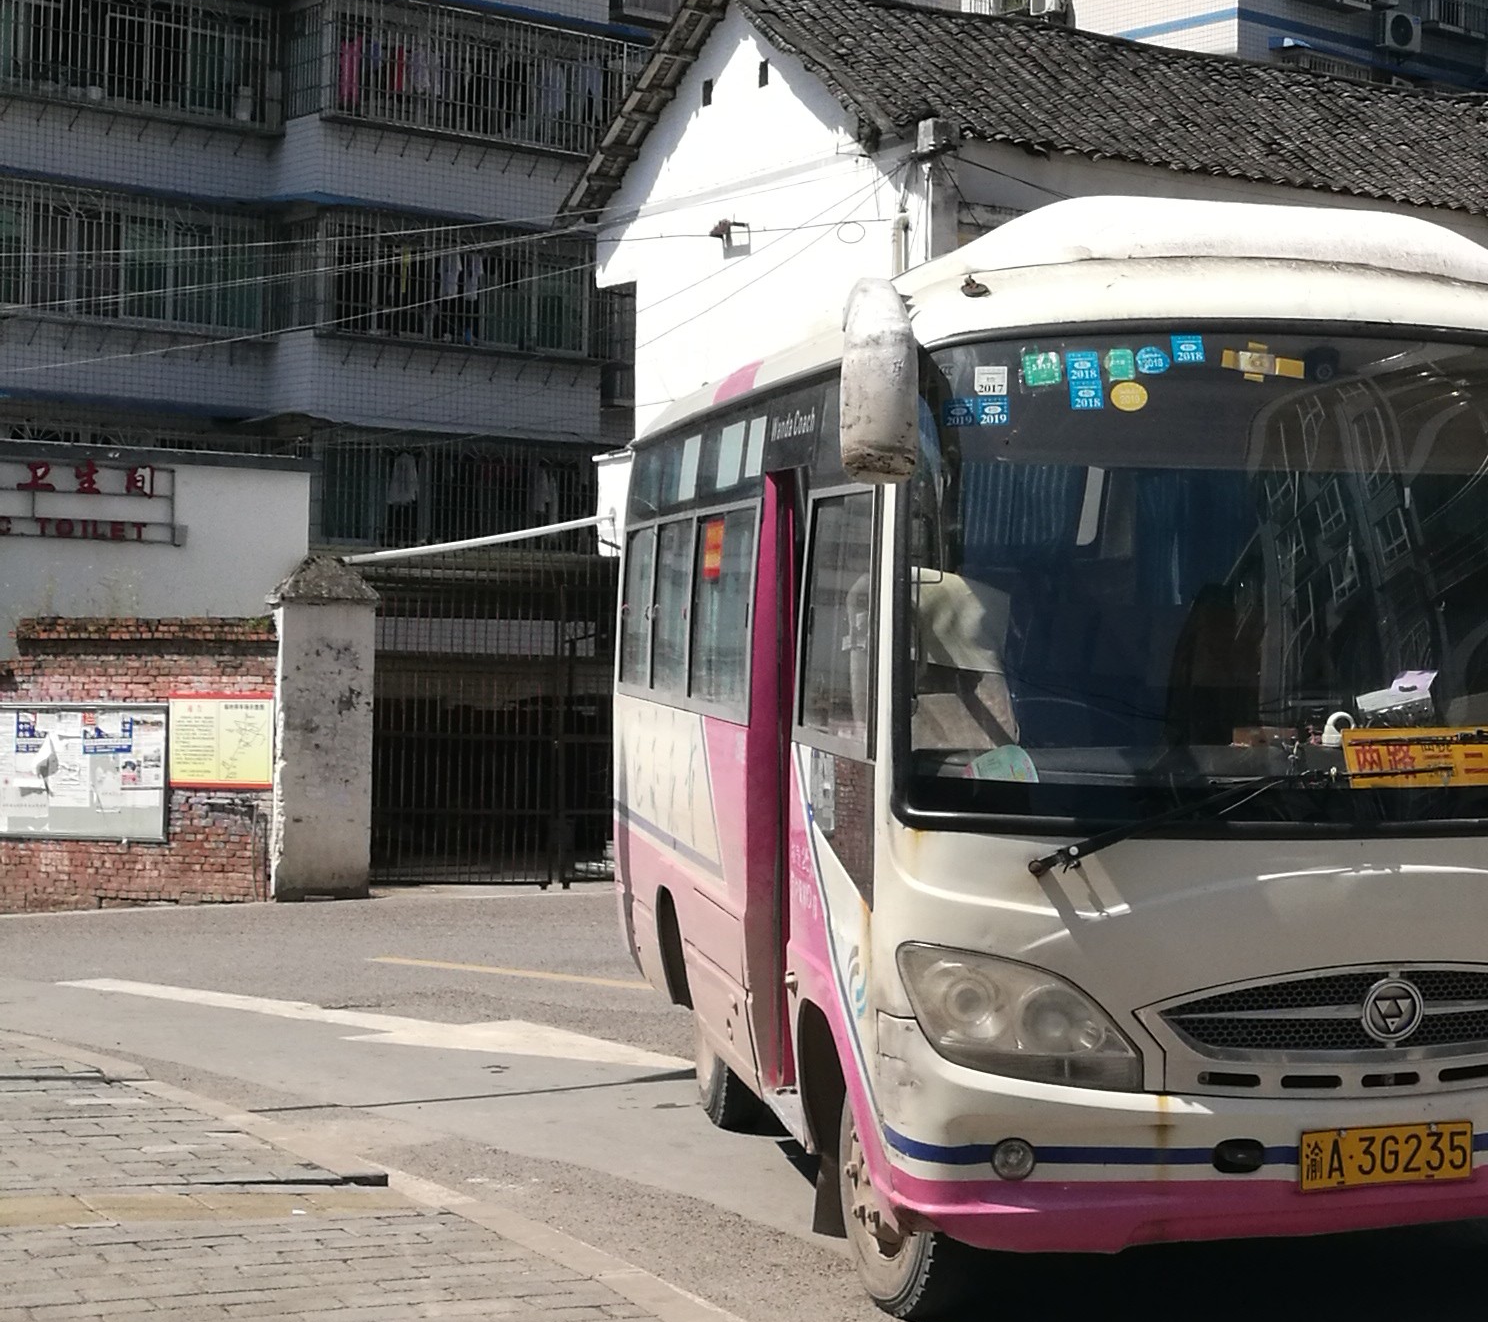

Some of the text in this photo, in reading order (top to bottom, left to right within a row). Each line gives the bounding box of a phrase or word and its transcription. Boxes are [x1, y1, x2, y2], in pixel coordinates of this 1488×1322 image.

[1177, 351, 1203, 361] 2018
[1070, 370, 1098, 380] 2018
[978, 384, 1004, 394] 2017
[1074, 398, 1101, 408] 2018
[770, 406, 815, 442] Wanda Coach
[946, 415, 973, 426] 2019
[980, 413, 1007, 425] 2019
[16, 458, 155, 499] 卫生间
[34, 518, 147, 541] TOILET
